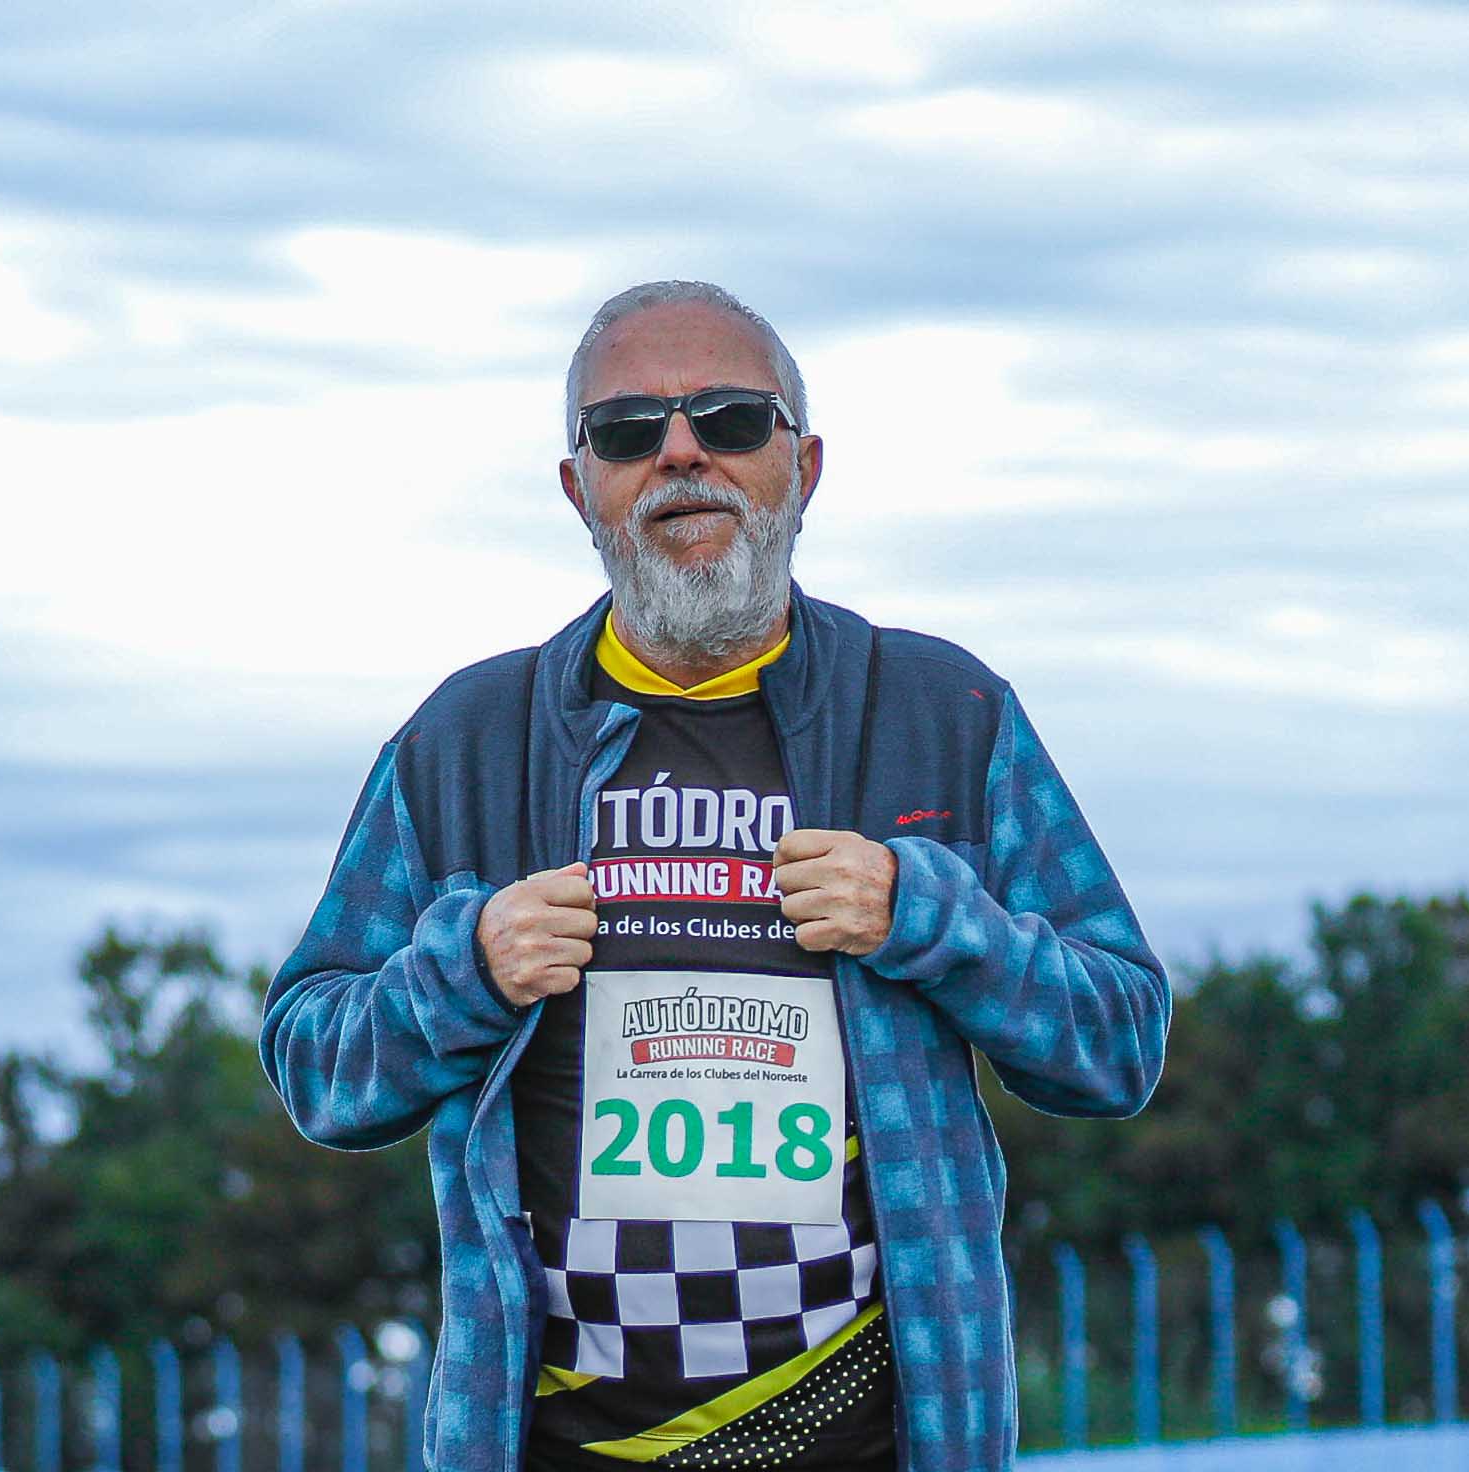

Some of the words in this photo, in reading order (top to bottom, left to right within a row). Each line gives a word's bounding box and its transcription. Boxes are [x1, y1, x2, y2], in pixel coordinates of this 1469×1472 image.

[591, 771, 795, 852] TÓDRO
[588, 861, 730, 899] UNNING
[615, 915, 643, 935] de
[649, 916, 681, 935] los
[686, 918, 762, 939] Clubes
[622, 986, 809, 1041] AUTÓDROMO
[648, 1037, 727, 1060] RUNNING
[732, 1040, 777, 1062] RACE
[616, 1068, 628, 1079] La
[629, 1069, 668, 1080] Carrera
[670, 1068, 684, 1079] de
[686, 1068, 701, 1079] los
[704, 1069, 741, 1080] Clubes
[743, 1069, 760, 1081] del
[763, 1070, 808, 1083] Noroeste
[590, 1098, 833, 1182] 2018
